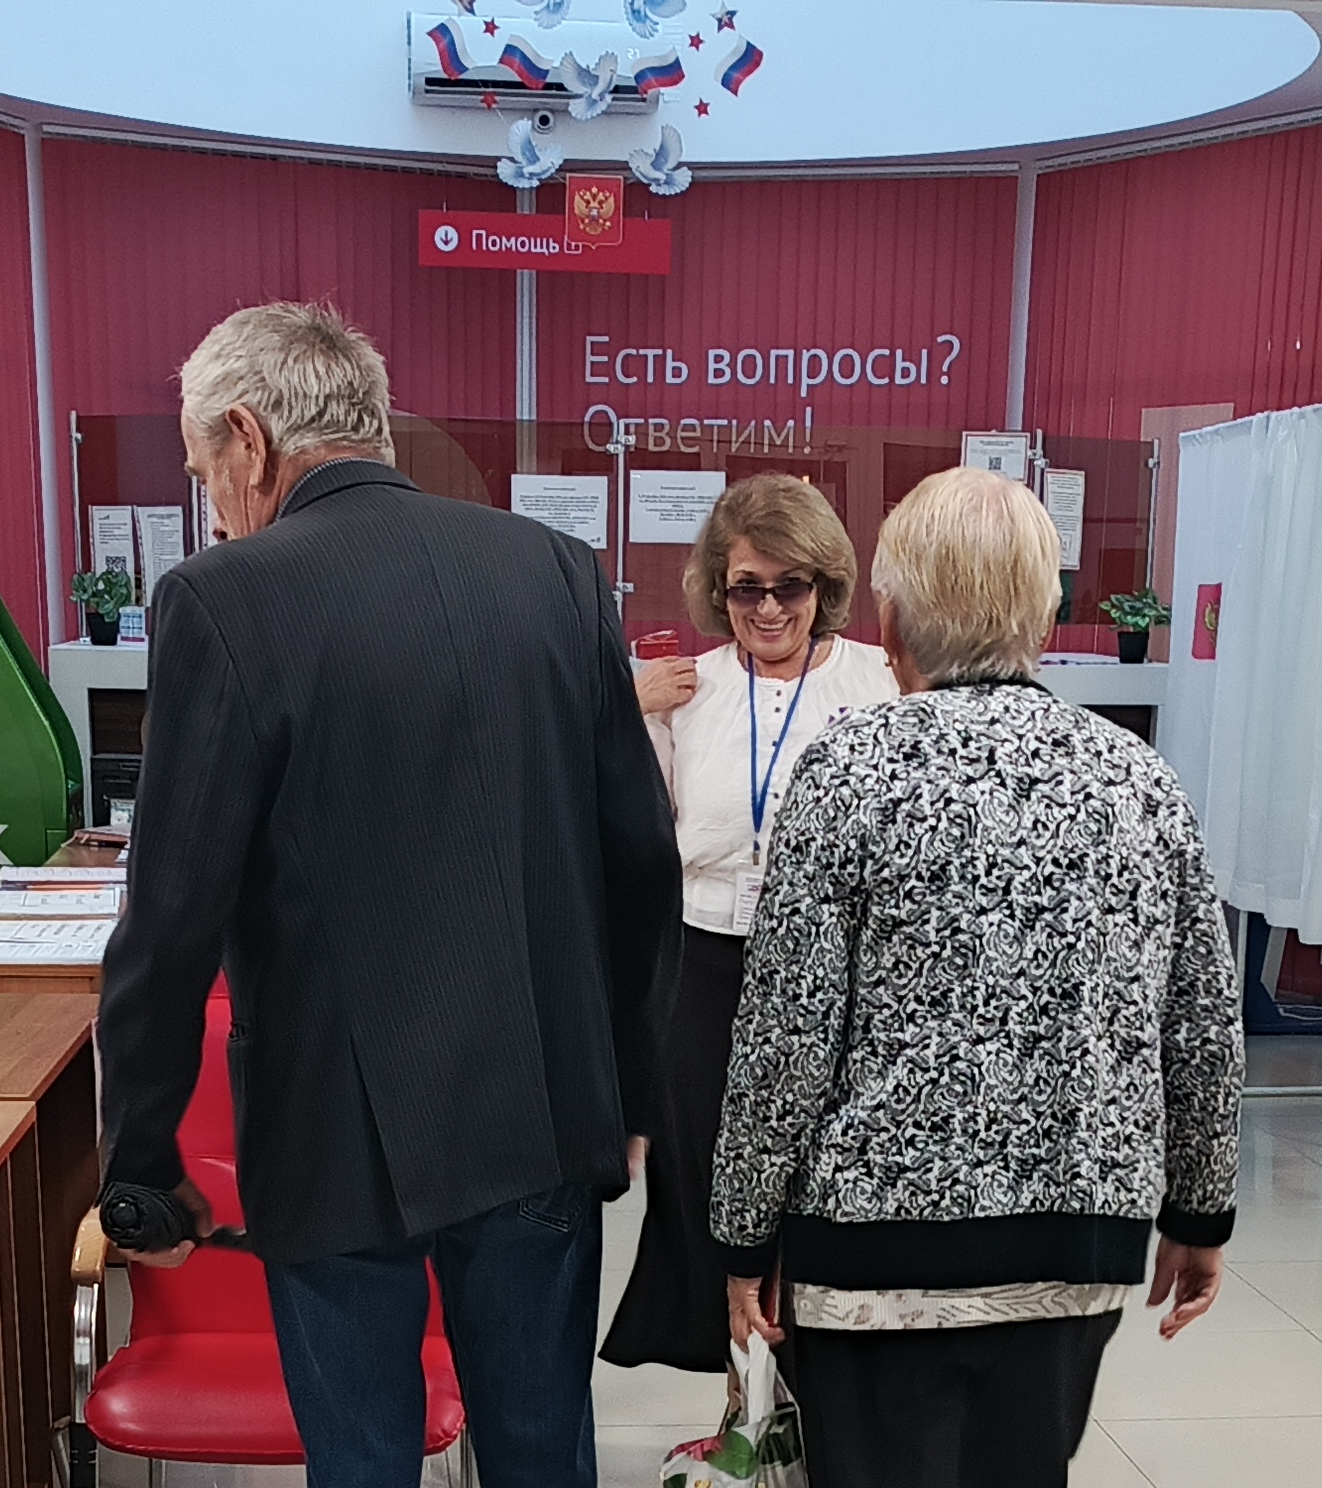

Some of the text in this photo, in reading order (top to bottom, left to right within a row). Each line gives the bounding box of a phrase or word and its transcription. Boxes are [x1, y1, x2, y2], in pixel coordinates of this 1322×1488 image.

[471, 230, 560, 256] Помощь
[583, 333, 962, 398] Есть вопросы?
[583, 404, 813, 455] Ответим!
